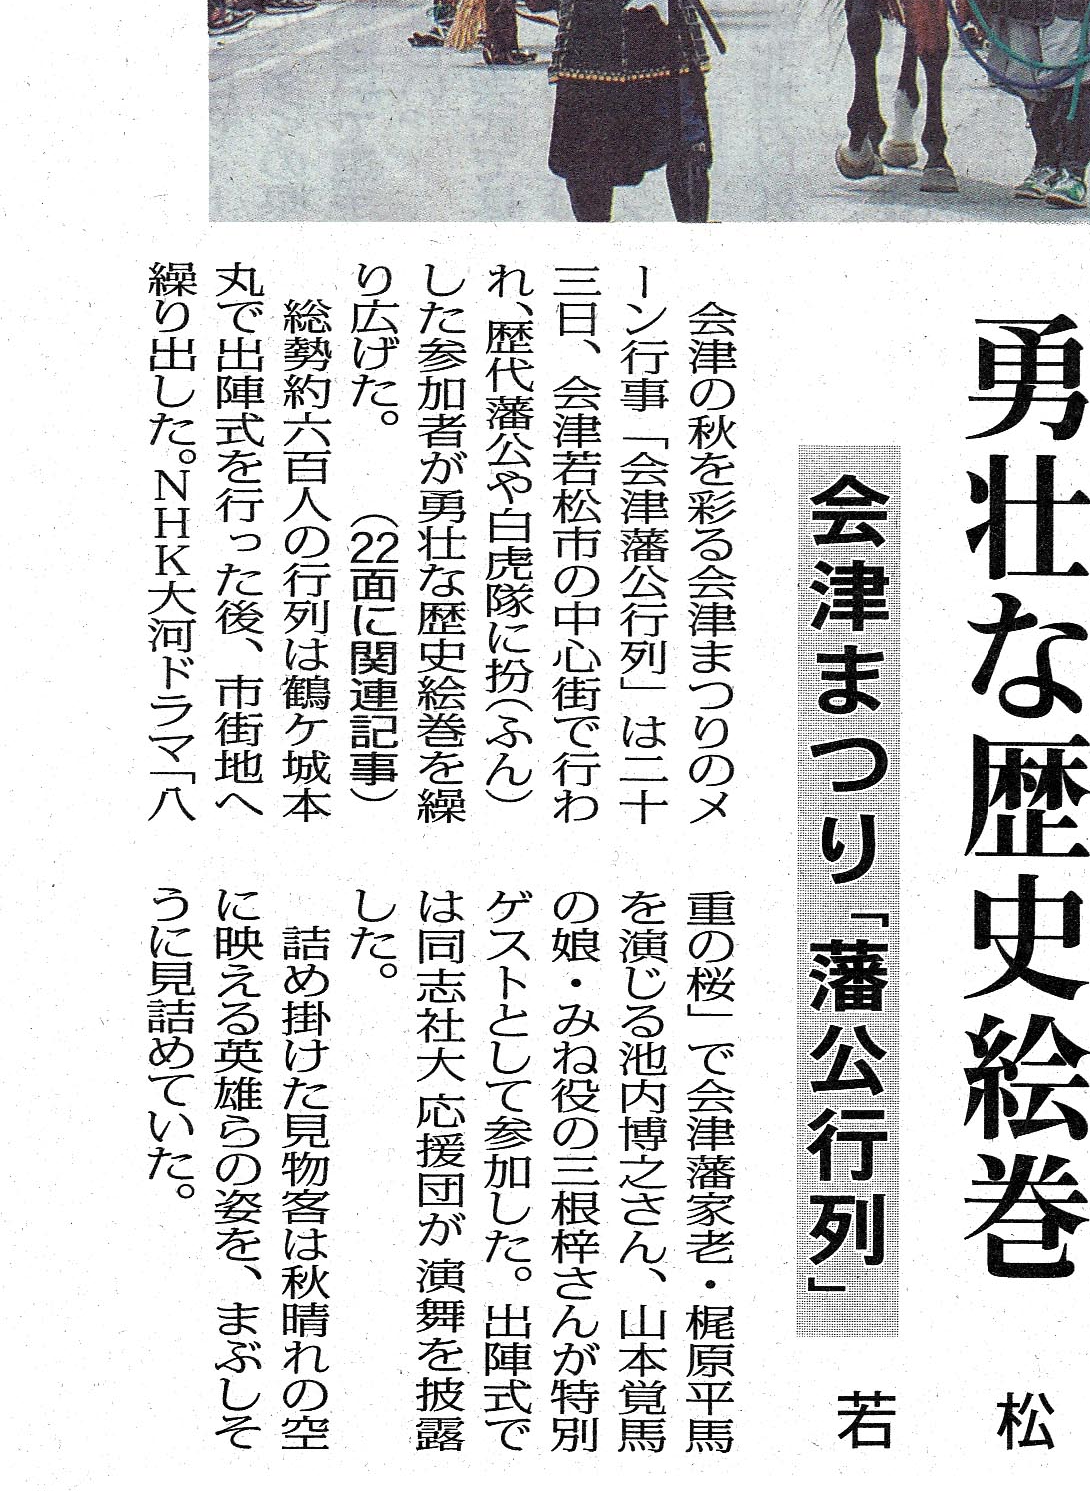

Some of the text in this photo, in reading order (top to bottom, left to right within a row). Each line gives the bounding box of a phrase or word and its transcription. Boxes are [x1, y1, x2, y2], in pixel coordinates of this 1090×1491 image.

[148, 262, 197, 821] 繰り出した。NHK大河ドラマ「八
[215, 262, 265, 815] 丸で出陣式を行った後、市街地へ
[351, 264, 399, 425] り広げた。
[417, 264, 467, 823] した参加者が勇壮な歴史絵巻を繰
[552, 266, 601, 823] 三日、会津若松市の中心街で行わ
[620, 266, 669, 824] ーン行事「会津藩公行列」は二十
[688, 302, 737, 823] 会津の秋を彩る会津まつりのメ
[147, 888, 195, 1199] うに見詰めていた。
[350, 889, 397, 978] した。
[806, 475, 889, 1291] 会津まつり「藩公行列」
[964, 314, 1090, 1278] 勇壮な歴史絵巻
[214, 889, 263, 1449] に映える英雄らの姿を、まぶしそ
[282, 926, 331, 1449] 詰め掛けた見物客は秋晴れの空
[484, 891, 532, 1451] ゲストとして参加した。出陣式で
[551, 892, 600, 1452] の娘・みね役の三根梓さんが特別
[618, 891, 668, 1453] を演じる池内博之さん、山本覚馬
[686, 891, 735, 1453] 重の桜」で会津藩家老・梶原平馬
[838, 1391, 1054, 1450] 若 松
